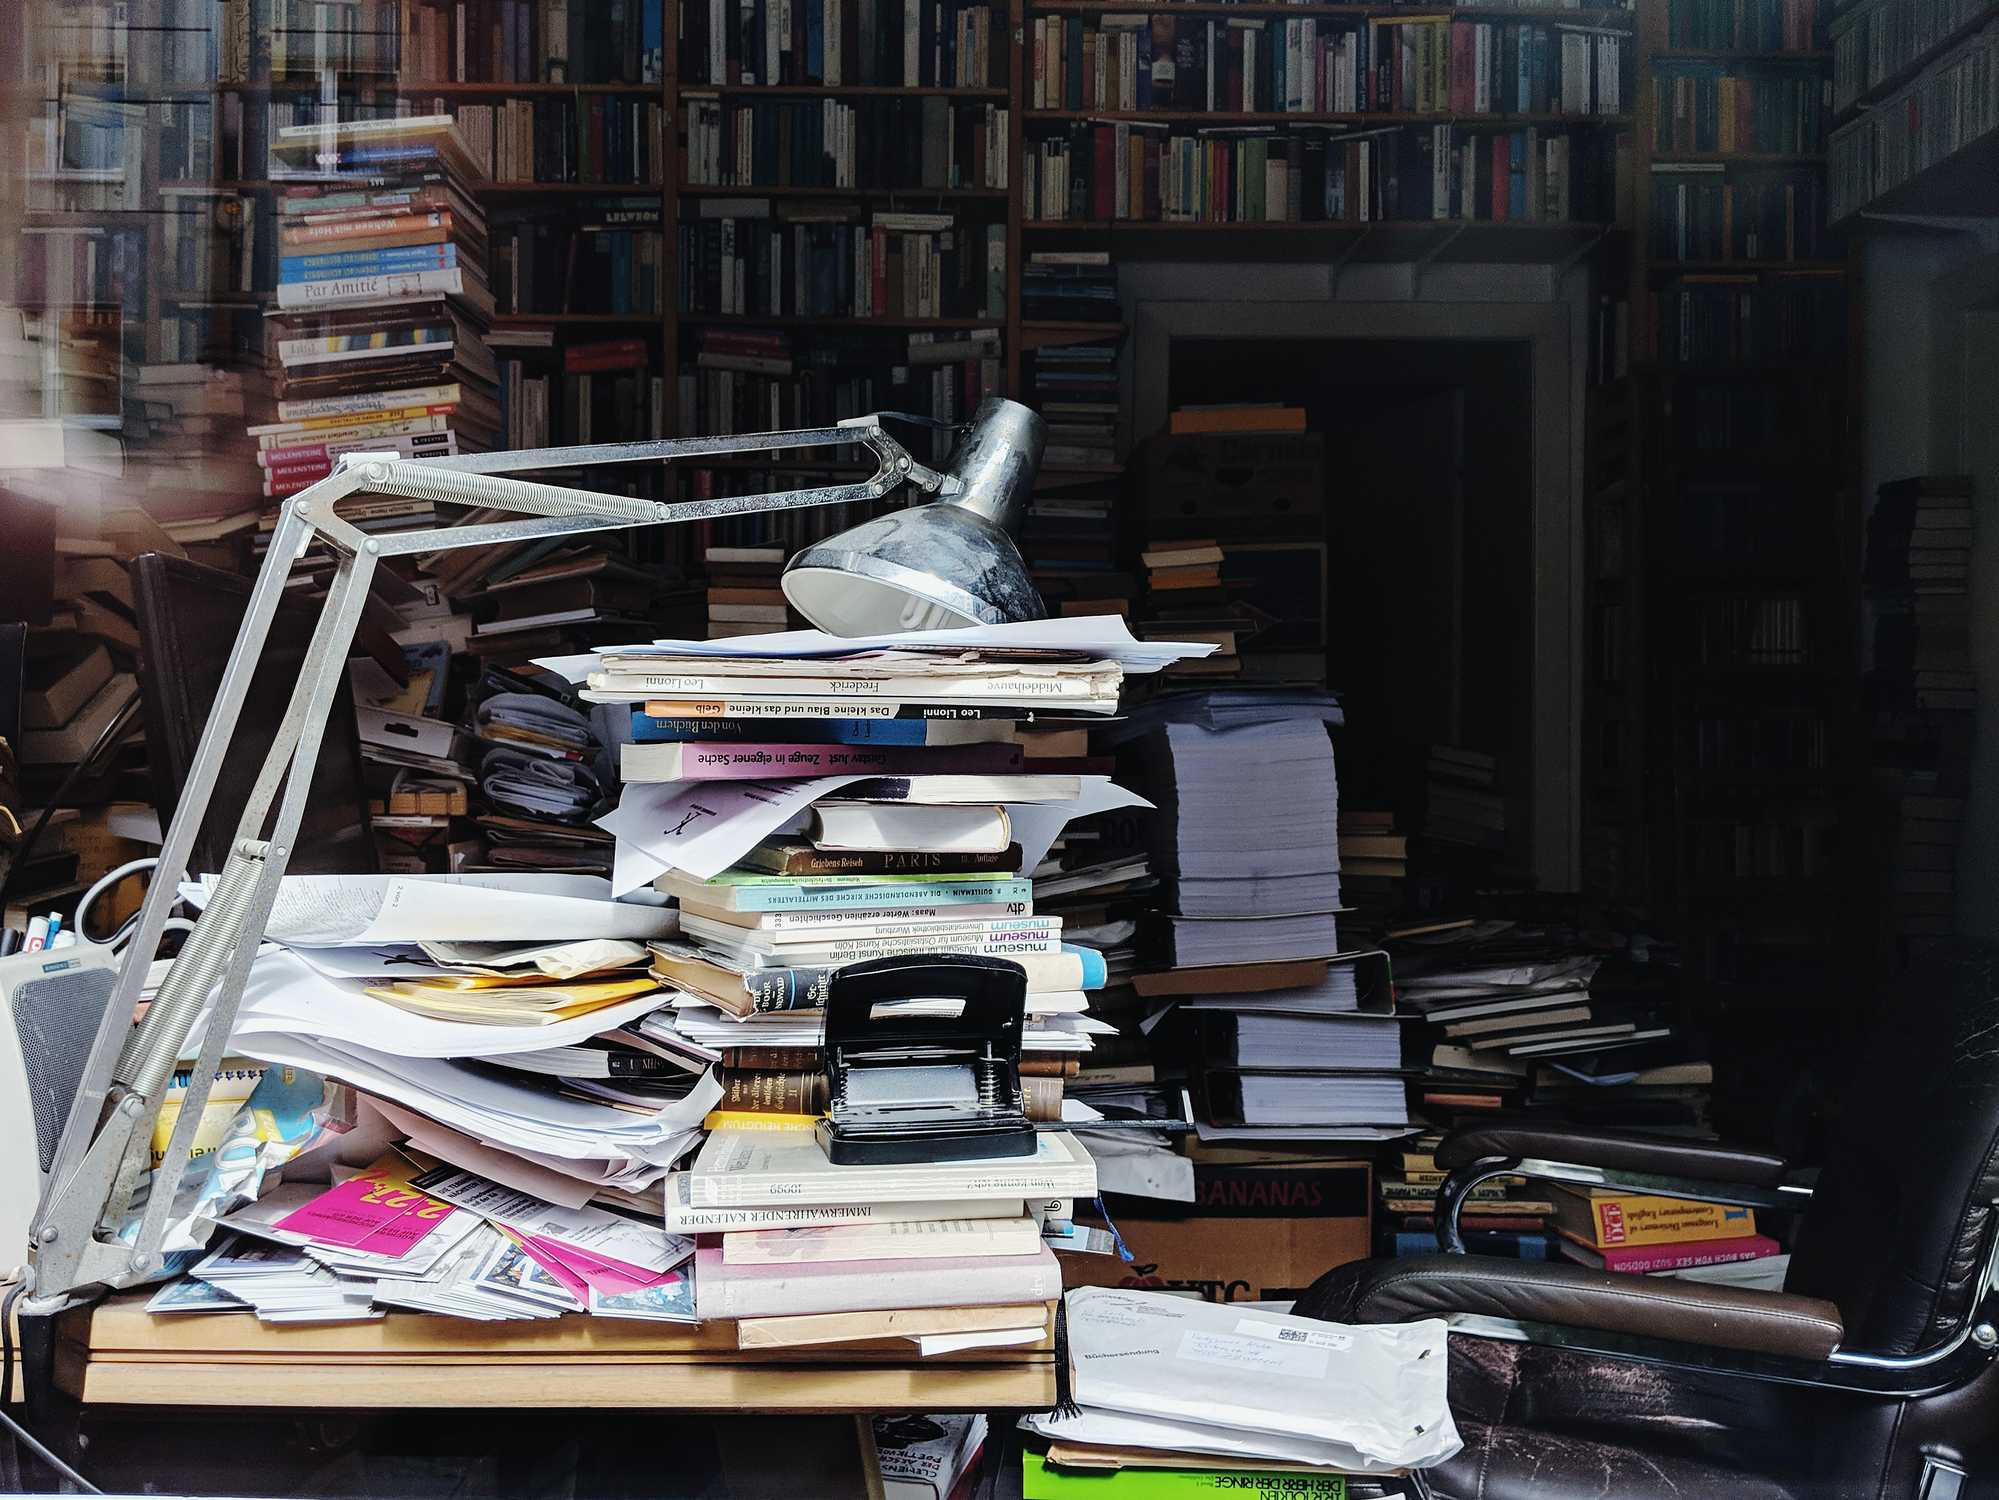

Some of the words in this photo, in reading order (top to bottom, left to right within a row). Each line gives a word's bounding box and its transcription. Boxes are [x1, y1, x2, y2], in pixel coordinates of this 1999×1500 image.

[304, 284, 328, 298] Par
[331, 278, 377, 296] Amitié
[271, 448, 322, 460] MEILENSTEINE
[277, 463, 327, 475] MEILENSTEINE
[646, 677, 681, 690] Lionni
[683, 678, 704, 690] Leo
[830, 680, 879, 693] Frederick
[988, 681, 1062, 693] Middelhauve
[695, 704, 720, 714] Gelb
[729, 704, 761, 715] kleine
[764, 704, 782, 715] das
[784, 705, 805, 716] und
[807, 705, 831, 716] Blau
[834, 706, 867, 716] kleine
[871, 706, 890, 716] Das
[924, 708, 957, 719] Lionni
[961, 708, 980, 719] Leo
[656, 720, 699, 734] Büchern
[701, 721, 719, 733] den
[720, 721, 742, 734] Von
[698, 753, 730, 766] Sache
[733, 750, 773, 765] eigener
[775, 753, 786, 765] in
[788, 751, 820, 765] Zeuge
[829, 753, 849, 765] Just
[884, 853, 942, 868] PARIS
[836, 893, 863, 902] KIRCHE
[953, 888, 993, 897] GUILLEMAIN
[768, 895, 819, 904] MITTELALTERS
[911, 908, 936, 918] Maas:
[1007, 902, 1026, 915] dtv
[789, 913, 843, 924] Geschichten
[845, 911, 880, 922] erzählen
[882, 910, 910, 920] Wörter
[991, 919, 1050, 931] museum
[882, 936, 936, 947] Ostasiatische
[938, 935, 949, 945] für
[950, 934, 984, 944] Museum
[990, 931, 1049, 942] museum
[834, 941, 855, 951] Köln
[856, 940, 880, 949] Kunst
[942, 945, 978, 956] Museum
[984, 943, 1047, 955] museum
[829, 951, 856, 961] Berlin
[857, 947, 885, 959] Kunst
[761, 981, 771, 1008] BOOR
[751, 1206, 871, 1222] IMMERWÄHRENDER
[1626, 1209, 1658, 1222] English
[1659, 1205, 1714, 1219] Contemporary
[679, 1212, 746, 1226] KALENDER
[1682, 1218, 1719, 1231] Longman
[1629, 1225, 1638, 1235] of
[1638, 1221, 1680, 1234] Dictionary
[1675, 1257, 1693, 1267] SEX
[1695, 1255, 1713, 1266] VOM
[1715, 1253, 1738, 1264] BUCH
[1740, 1251, 1756, 1261] DAS
[1614, 1260, 1650, 1272] GODSON
[1084, 1346, 1160, 1361] Büchersendung
[1215, 1476, 1254, 1489] RINGE
[1255, 1478, 1281, 1490] DER
[1282, 1479, 1314, 1492] HERR
[1315, 1479, 1342, 1492] DER
